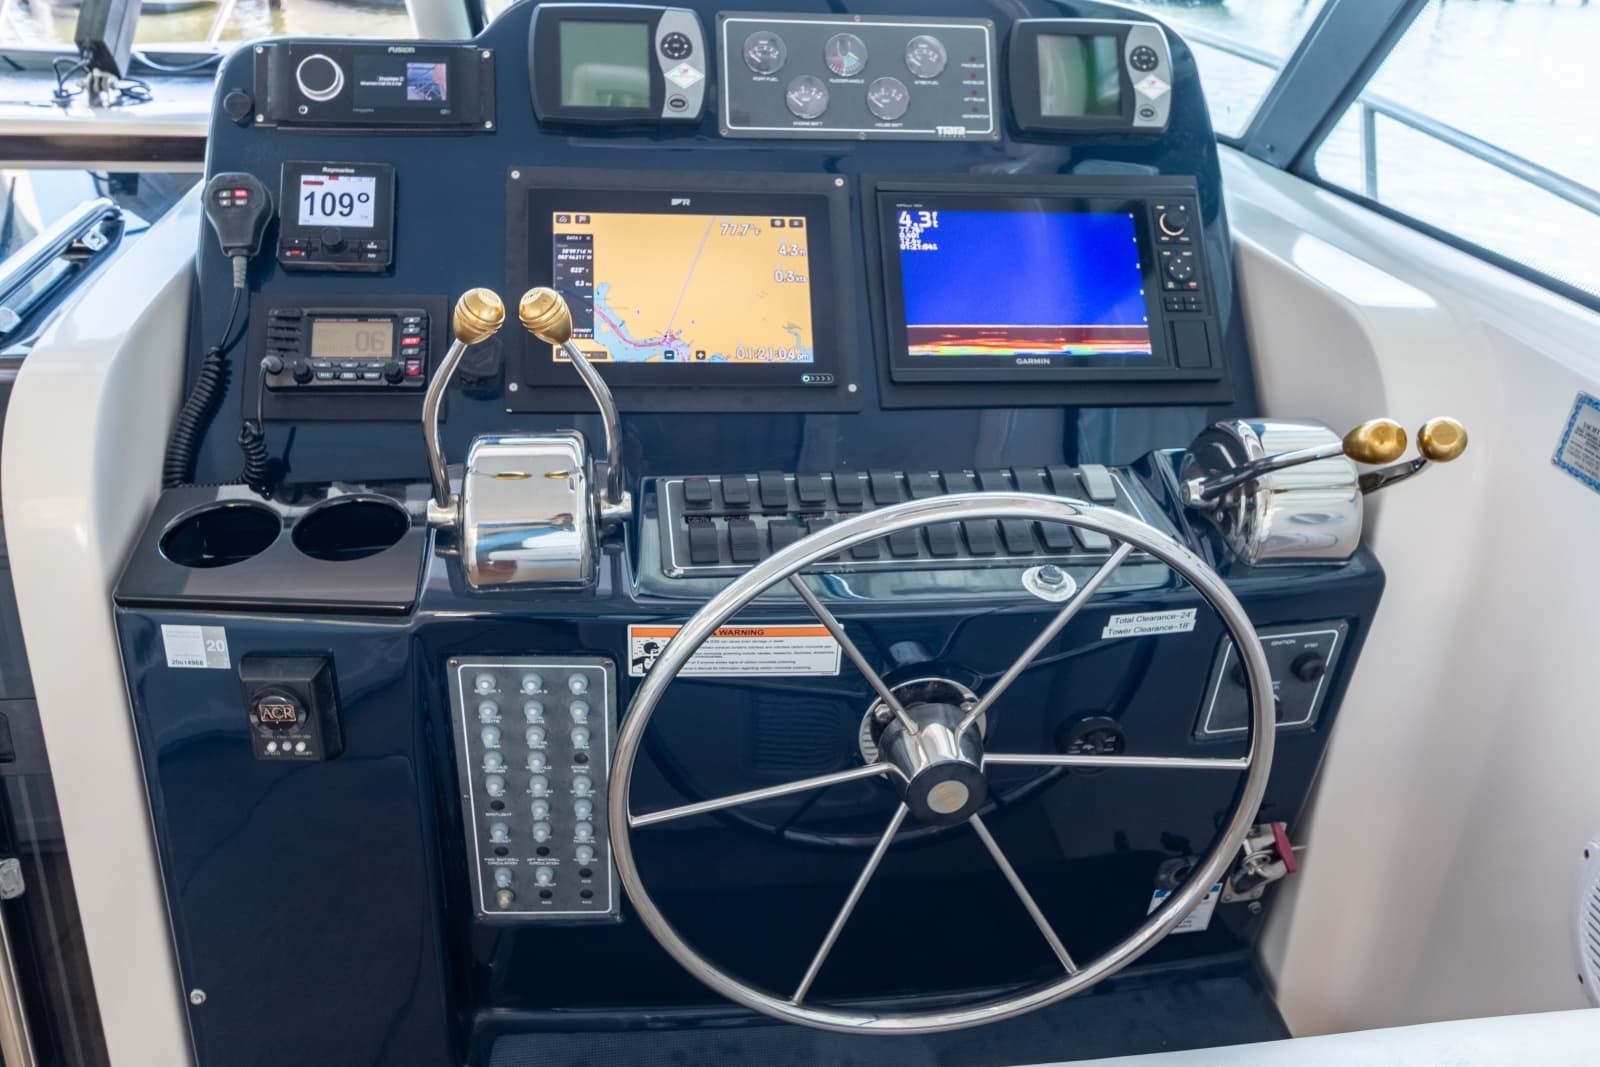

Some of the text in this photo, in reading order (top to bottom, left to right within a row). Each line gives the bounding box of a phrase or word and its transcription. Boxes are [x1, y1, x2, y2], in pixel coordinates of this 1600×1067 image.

[1115, 616, 1135, 625] Total
[206, 640, 225, 651] 20
[263, 706, 294, 719] ACR
